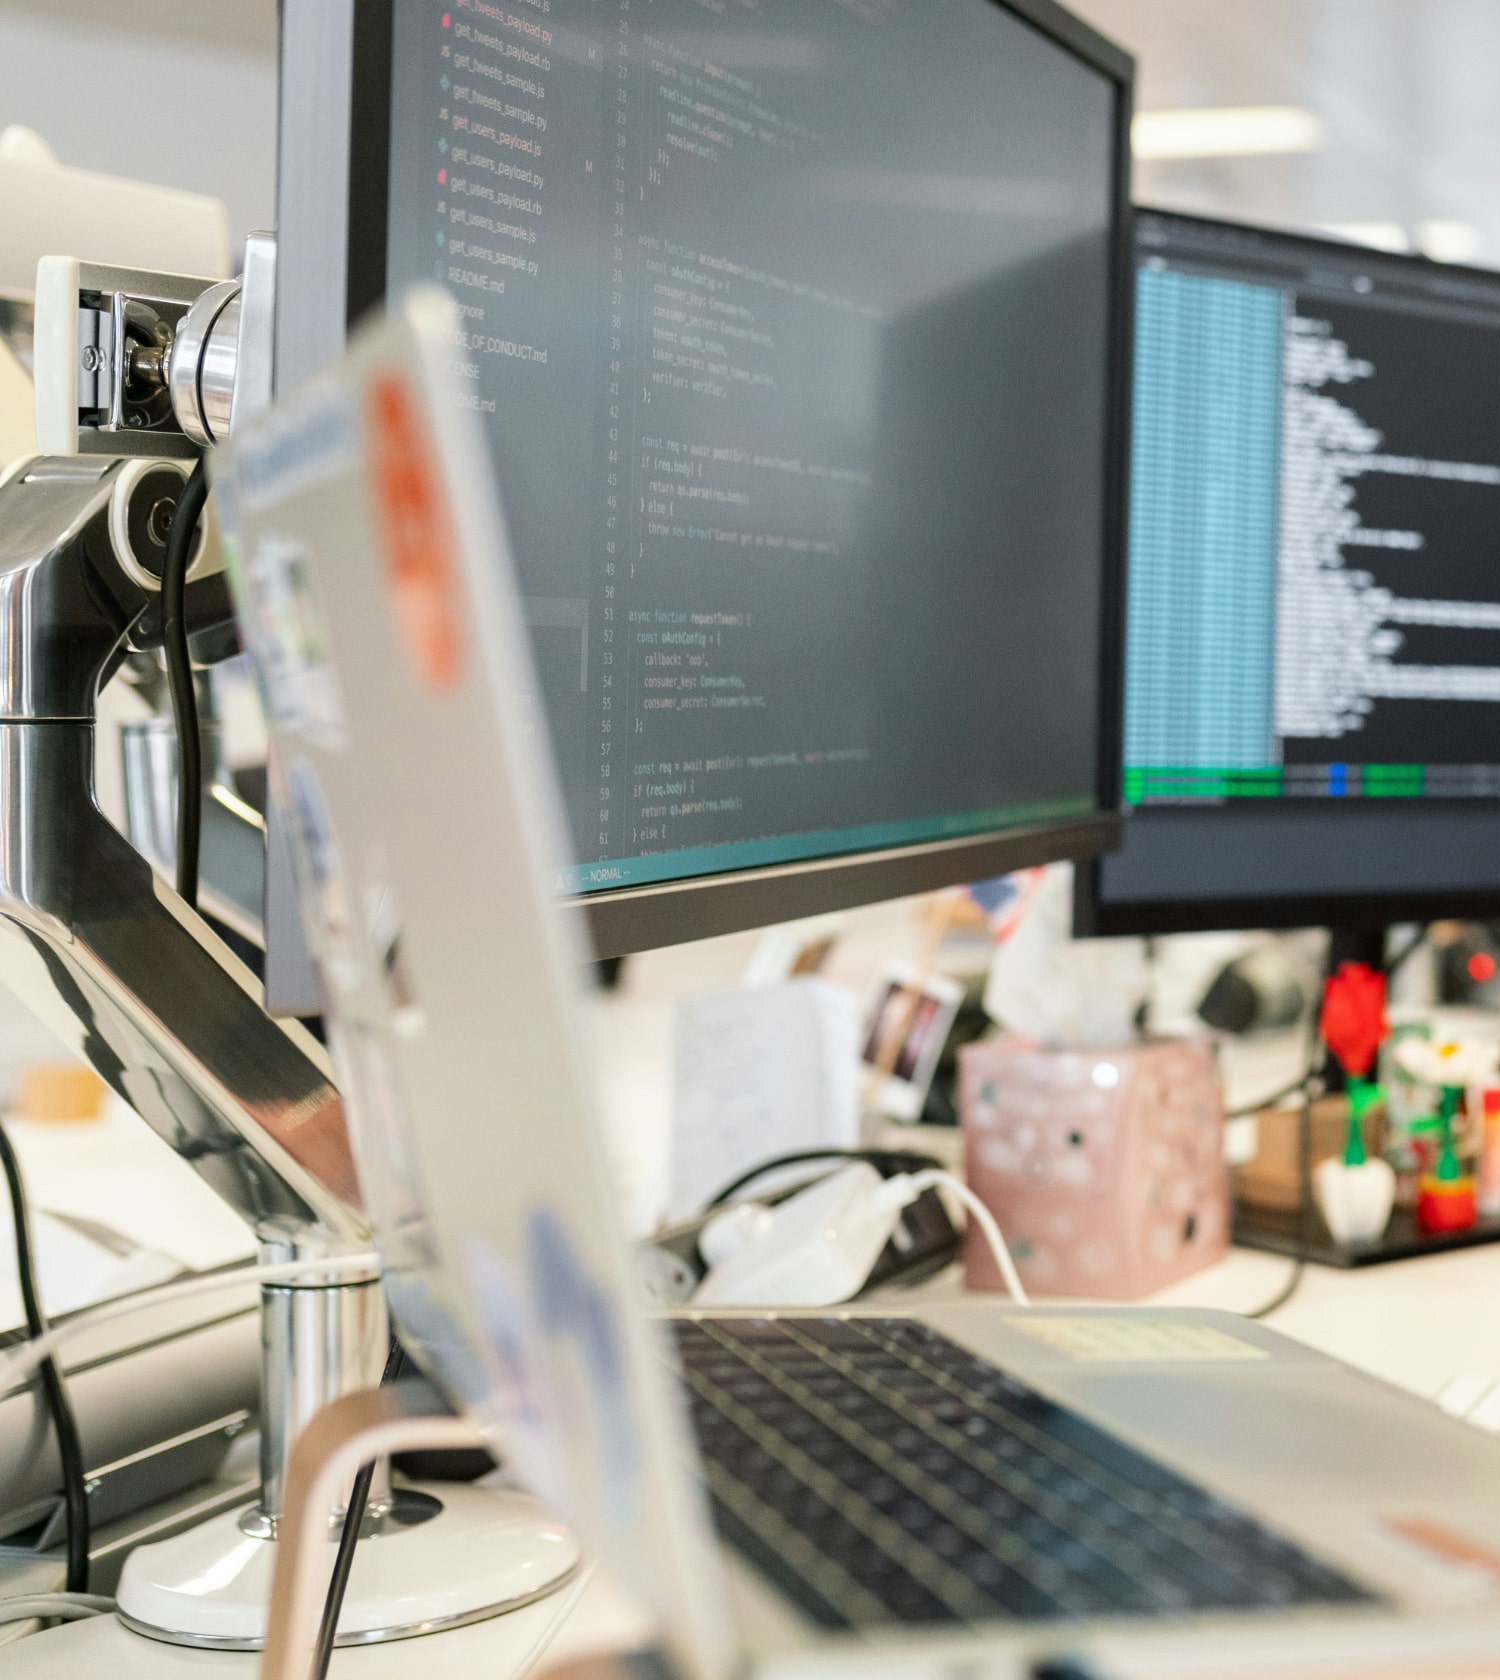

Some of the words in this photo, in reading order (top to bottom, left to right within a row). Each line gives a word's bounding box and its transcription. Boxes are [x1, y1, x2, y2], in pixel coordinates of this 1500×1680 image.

[455, 23, 551, 71] get_tweets_payload.rb
[454, 53, 545, 99] get_tweets_sample.js
[617, 88, 627, 103] 28
[453, 84, 547, 131] get_tweets_sample.py
[452, 115, 542, 157] get_users_payload.js
[451, 146, 544, 190] get_users_payload.py
[615, 178, 624, 193] 32
[450, 177, 542, 216] get_users_payload.rb
[614, 201, 623, 216] 33
[450, 207, 536, 244] get_users_sample.js
[613, 223, 623, 238] 34
[449, 239, 539, 276] get_users_sample.py
[612, 246, 622, 261] 35
[449, 267, 505, 294] README.md
[612, 268, 622, 282] 36
[612, 291, 621, 305] 37
[611, 314, 621, 329] 38
[447, 330, 547, 363] ODE_OF_CONDUCT.md
[611, 336, 620, 351] 39
[609, 382, 619, 396] 41
[608, 404, 618, 418] 42
[608, 428, 618, 441] 43
[607, 473, 616, 486] 45
[606, 495, 616, 508] 46
[606, 516, 615, 529] 47
[605, 540, 615, 553] 48
[605, 562, 614, 575] 49
[603, 607, 613, 620] 51
[603, 629, 613, 642] 52
[603, 651, 613, 664] 53
[602, 674, 612, 688] 54
[602, 696, 611, 709] 55
[601, 719, 611, 732] 56
[600, 742, 611, 755] 57
[600, 764, 610, 777] 58
[600, 787, 609, 800] 59
[599, 832, 608, 845] 61
[640, 826, 658, 840] else
[590, 867, 622, 882] NORMAL
